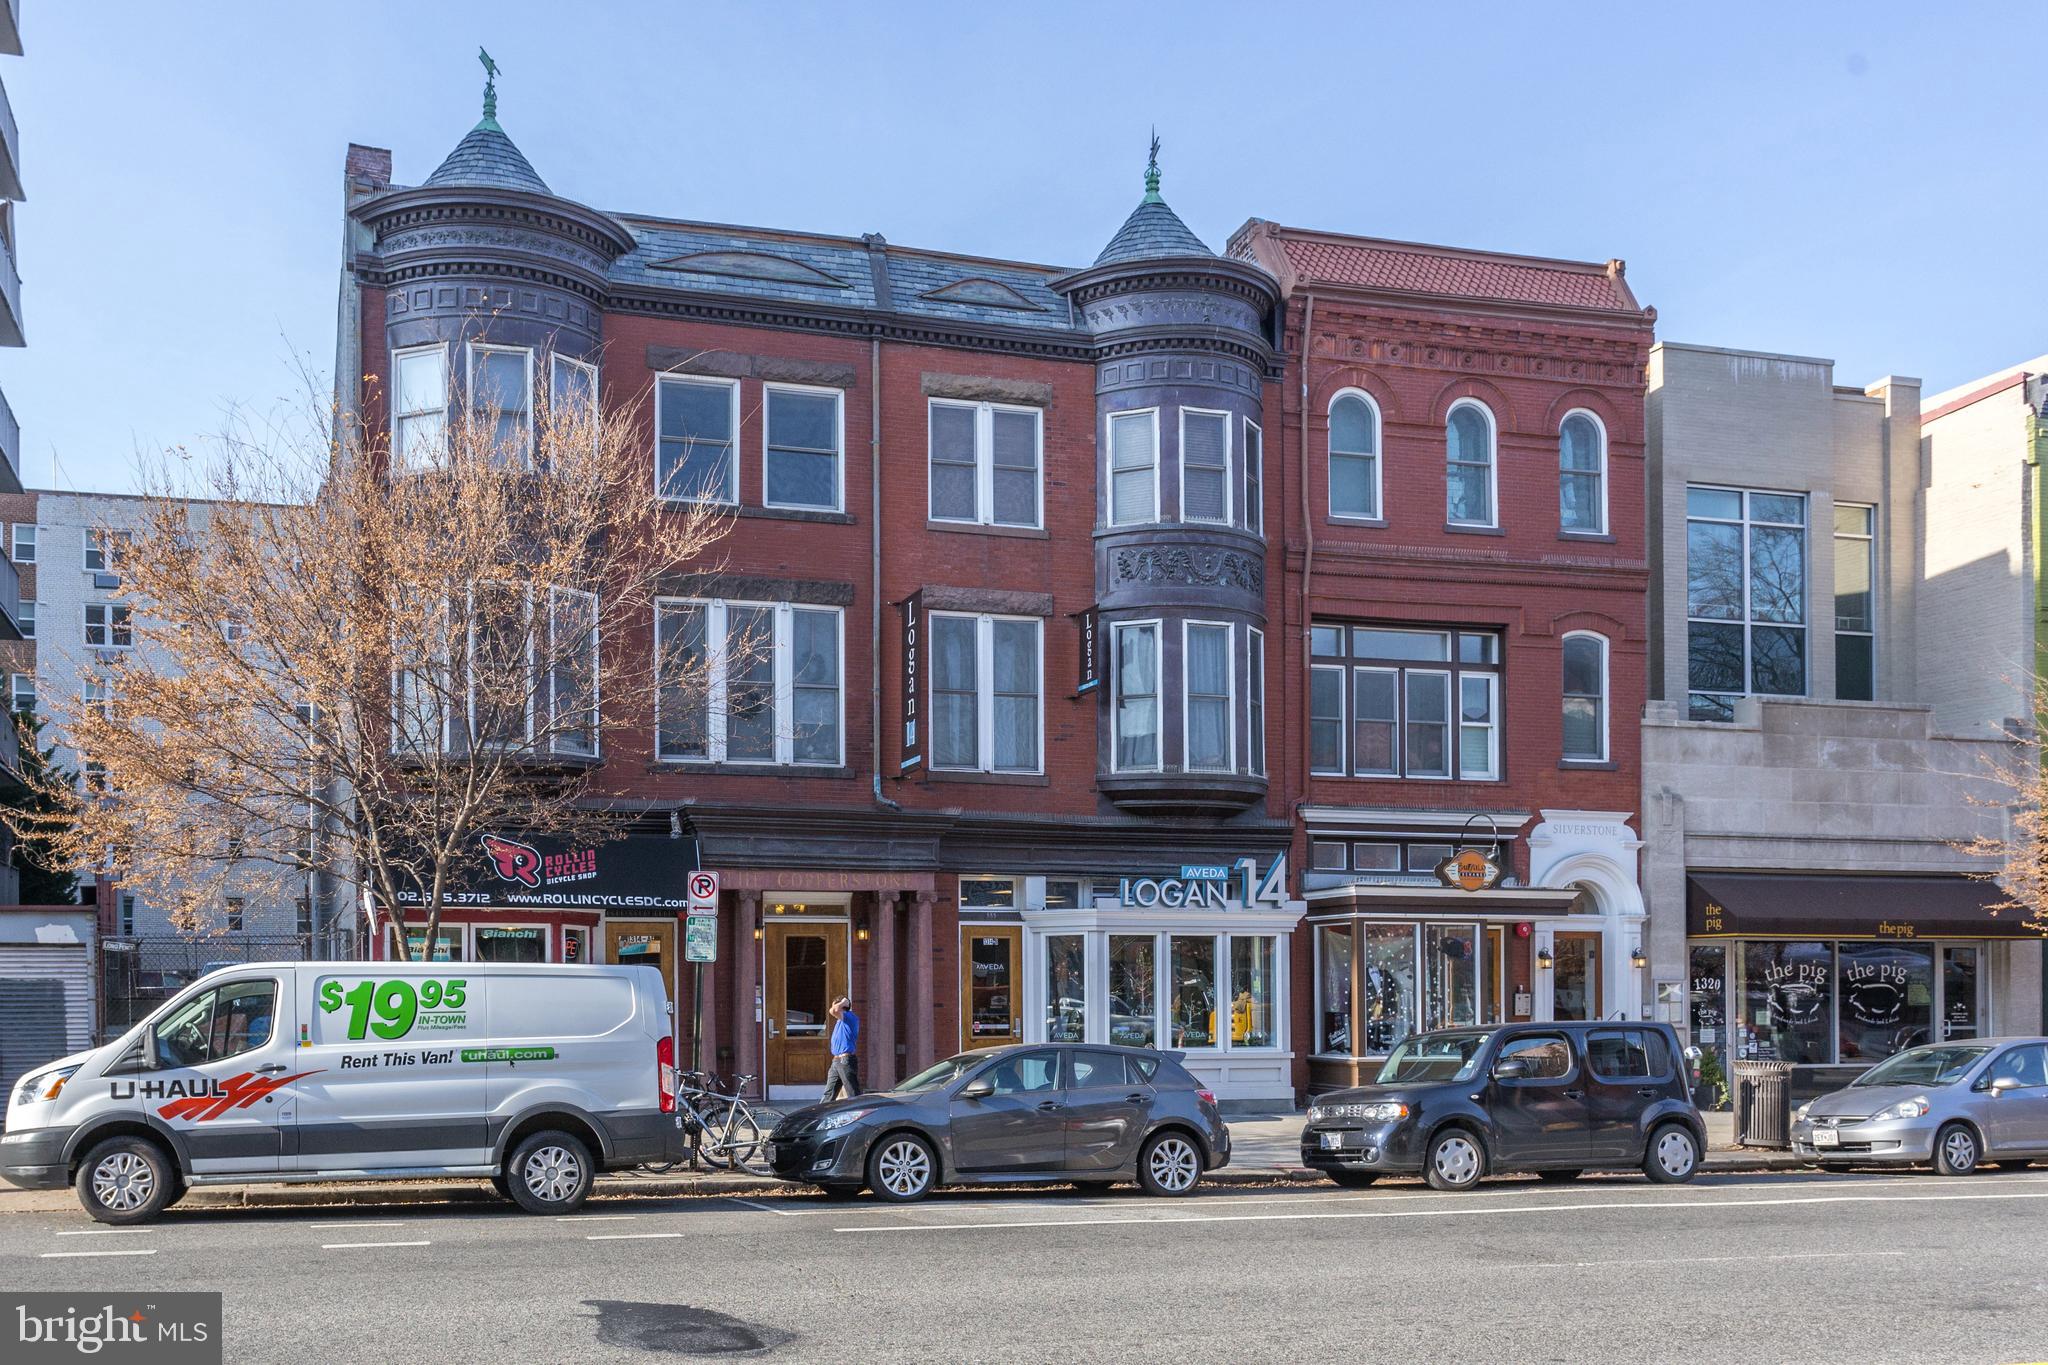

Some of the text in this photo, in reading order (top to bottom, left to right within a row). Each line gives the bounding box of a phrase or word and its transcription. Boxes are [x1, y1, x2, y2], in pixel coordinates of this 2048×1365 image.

[907, 601, 916, 716] Logan
[1552, 823, 1618, 836] SILVERSTONE
[545, 860, 597, 878] CYCLES
[1186, 867, 1226, 878] AVEDA
[546, 874, 576, 885] BICYCLE
[1120, 850, 1290, 909] LOGAN 14
[507, 893, 688, 908] www.ROLLINCYCLESDC.com
[1705, 903, 1722, 915] the
[1705, 917, 1723, 931] pig
[1879, 920, 1914, 938] the pig
[483, 928, 538, 939] Bianchi
[409, 945, 448, 954] Biachi
[1764, 960, 1828, 984] the pig
[1847, 960, 1908, 984] the pig
[1694, 977, 1721, 991] 1320
[418, 1015, 467, 1025] IN-TOWN
[1053, 1032, 1079, 1040] AVEDA
[340, 1054, 378, 1070] Rent
[383, 1052, 416, 1067] This
[421, 1050, 454, 1066] Van!
[110, 1078, 228, 1100] U-HAUL
